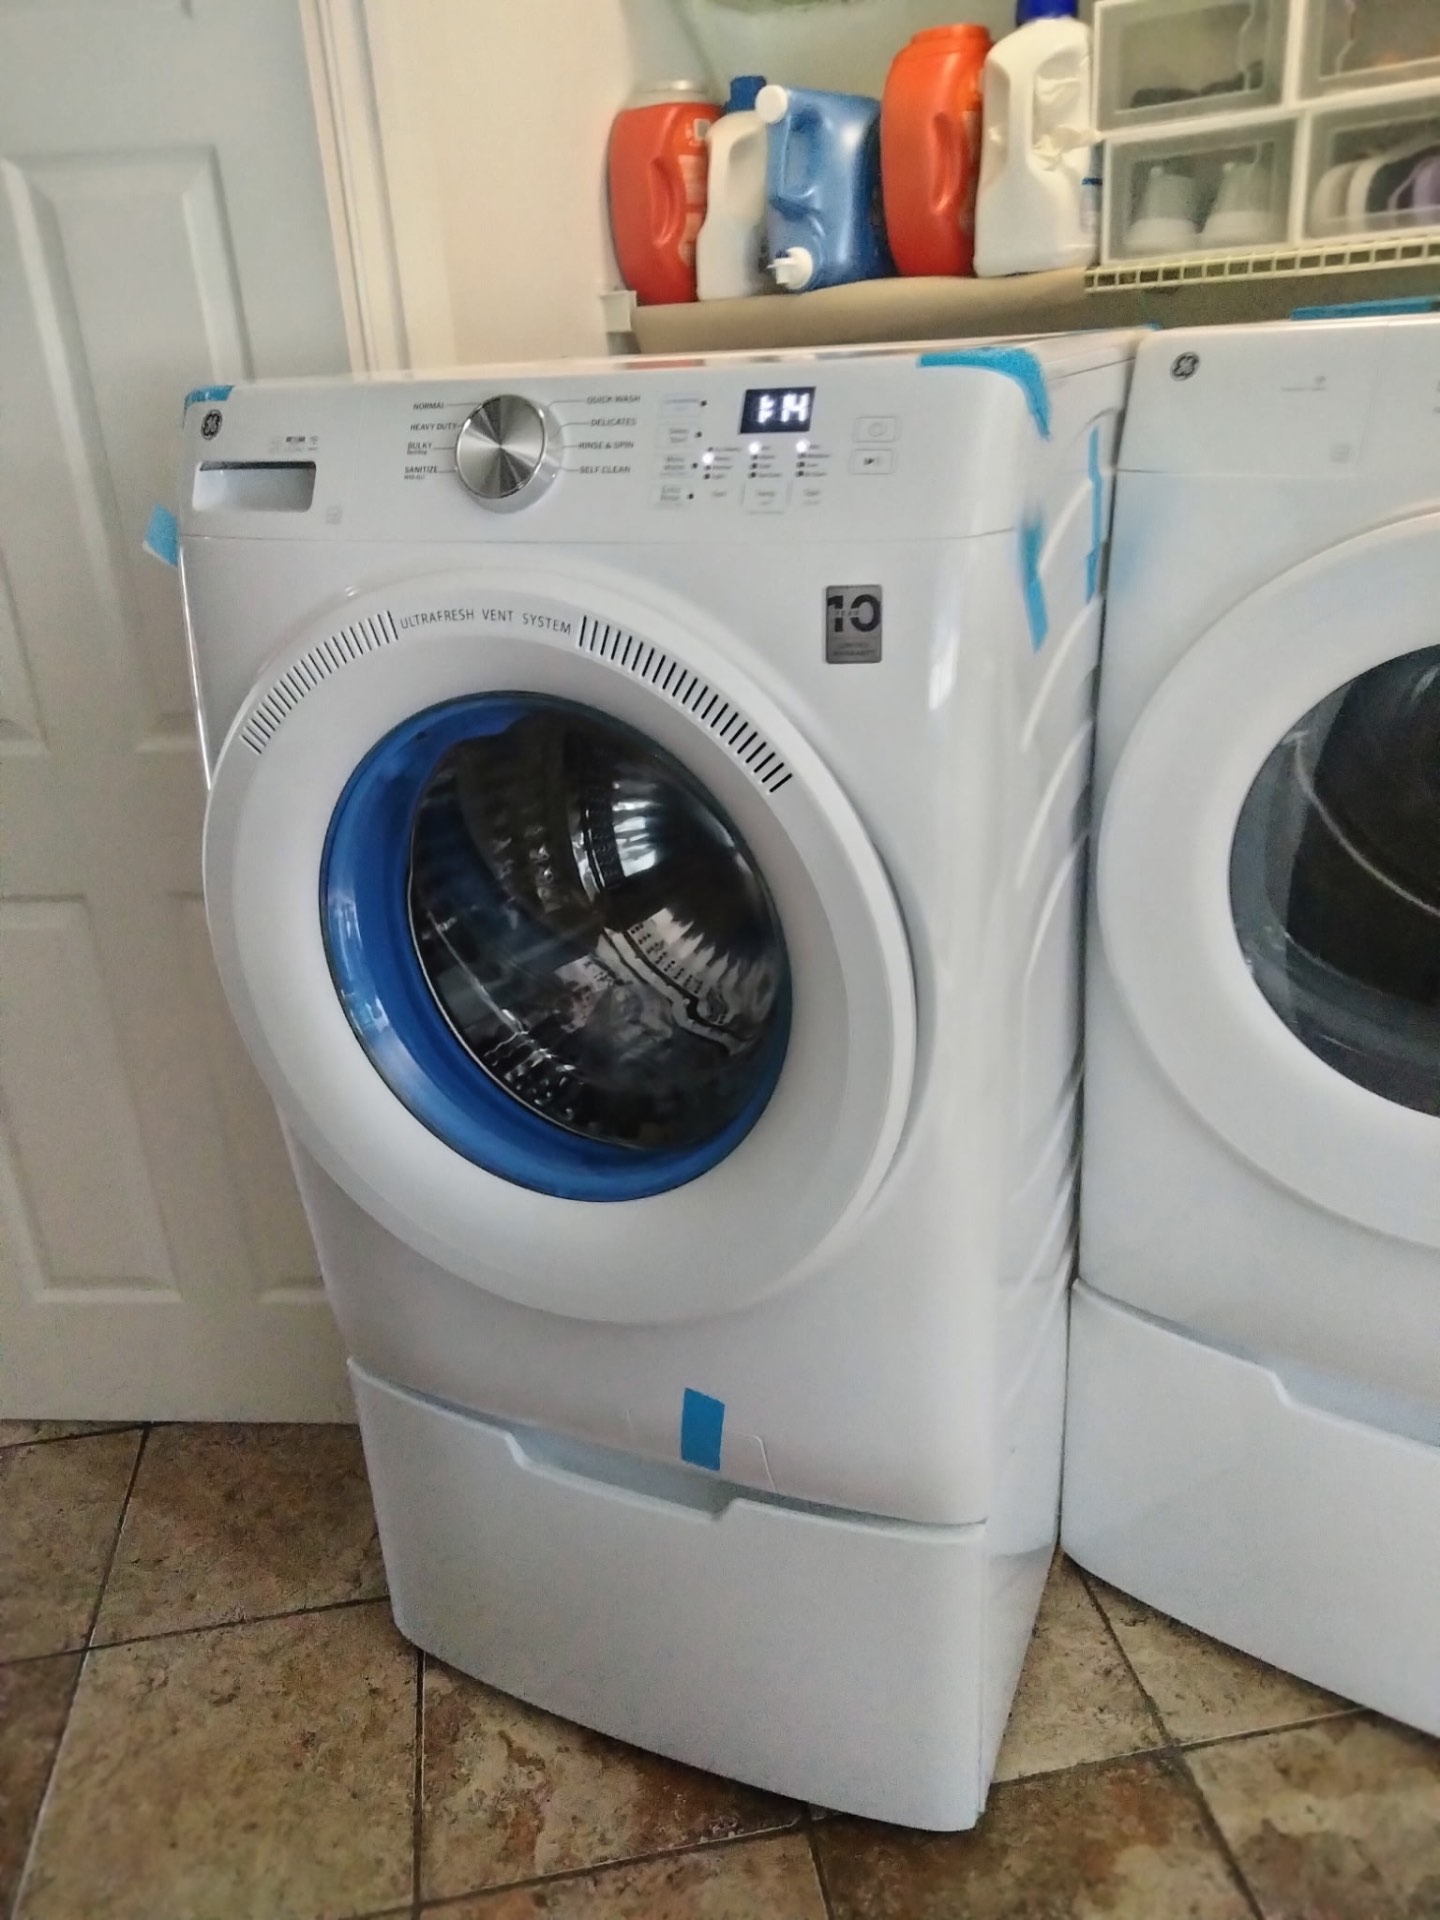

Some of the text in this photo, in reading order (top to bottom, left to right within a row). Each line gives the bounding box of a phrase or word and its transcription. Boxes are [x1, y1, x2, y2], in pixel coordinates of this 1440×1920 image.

[586, 394, 641, 404] QUICK WASH
[413, 401, 445, 410] NORMAL
[410, 422, 457, 431] HEAVY DUTY
[590, 418, 637, 426] DELICATES
[407, 441, 432, 449] BULKY
[578, 441, 604, 449] RINSE
[613, 441, 635, 449] SPIN
[404, 465, 438, 474] SANITIZE
[578, 465, 631, 474] SELF CLEAN
[826, 594, 882, 633] 10
[400, 608, 572, 636] ULTRAFRESH VENT SYSTEM
